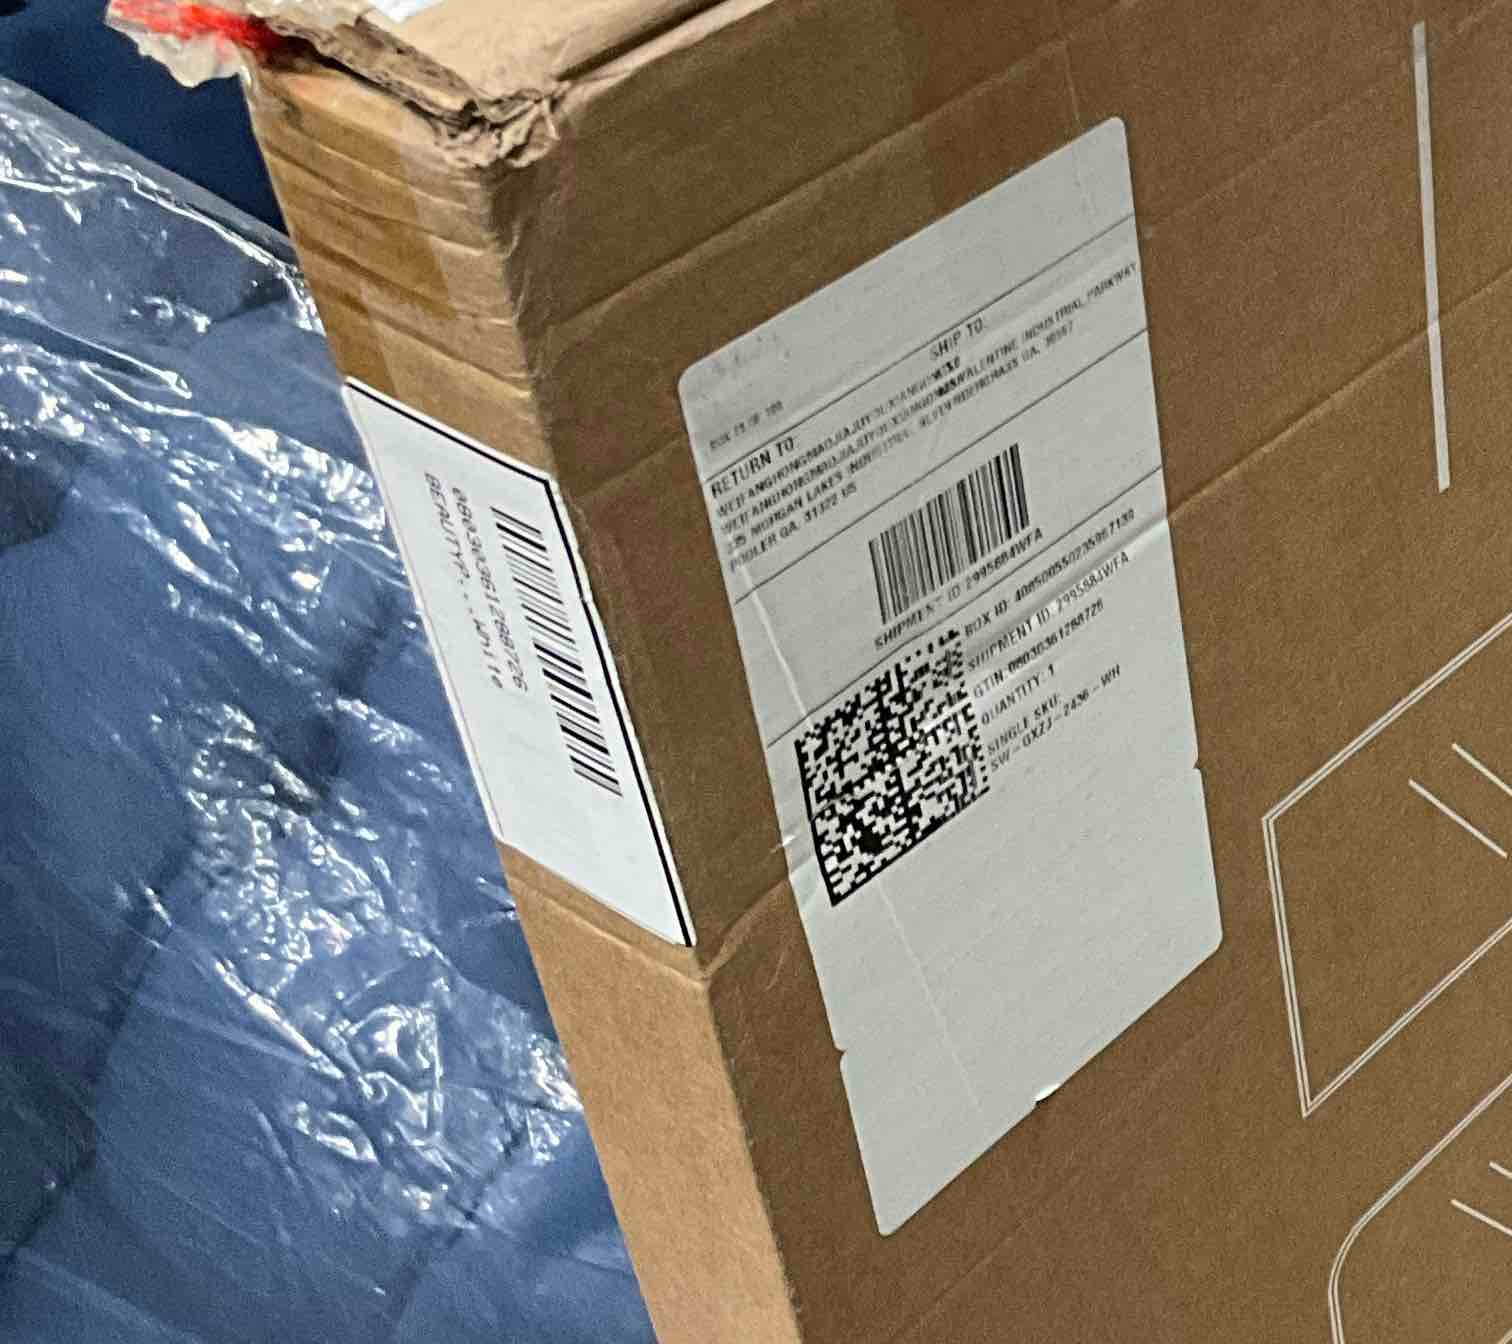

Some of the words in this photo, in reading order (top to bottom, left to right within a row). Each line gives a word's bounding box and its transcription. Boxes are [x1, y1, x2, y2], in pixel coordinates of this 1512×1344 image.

[932, 330, 961, 358] SHIP
[711, 449, 771, 497] RETURN
[964, 609, 991, 637] BOX
[987, 717, 1027, 754] SINGLE
